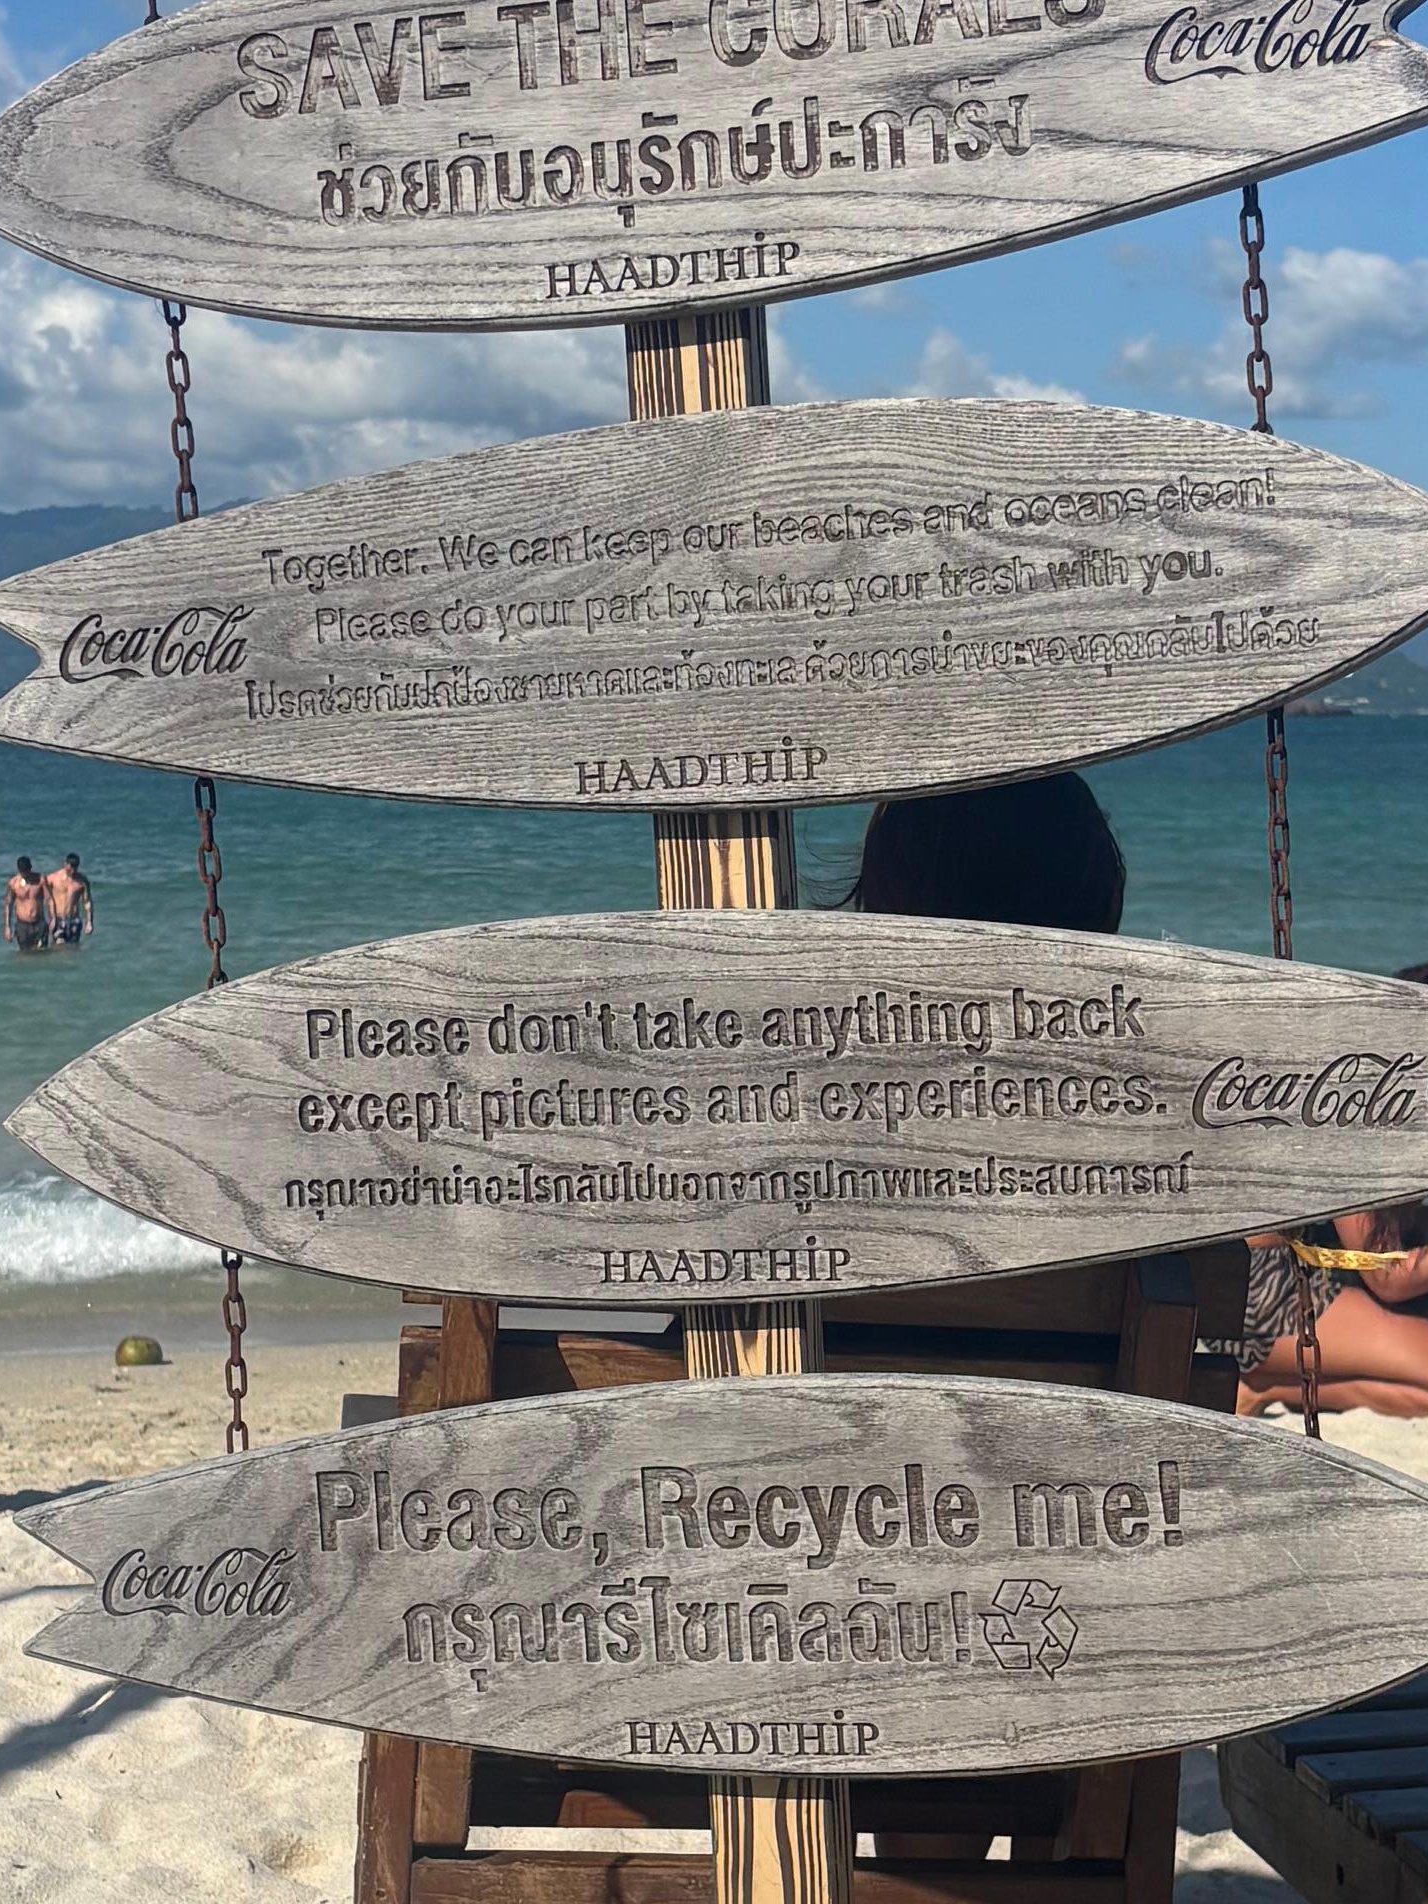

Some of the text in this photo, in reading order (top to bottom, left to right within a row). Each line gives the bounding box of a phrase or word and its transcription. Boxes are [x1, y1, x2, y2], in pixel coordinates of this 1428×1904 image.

[237, 11, 471, 120] SAVE
[438, 534, 498, 571] We
[509, 535, 573, 567] can
[582, 525, 671, 566] keep
[681, 520, 744, 554] our
[752, 504, 914, 548] beaches
[922, 492, 992, 534] and
[1003, 488, 1146, 527] oceans
[1156, 467, 1276, 514] clean!
[316, 547, 1225, 644] Please do your part by taking your trash with you.
[59, 602, 254, 684] Coca-Cola
[306, 984, 1146, 1060] Please don't take anything back
[298, 1065, 1168, 1142] except pictures and experiences.
[1191, 1052, 1427, 1130] Coca-Cola
[315, 1459, 1184, 1569] Please, Recycle me!
[102, 1546, 299, 1619] Coca-Cola
